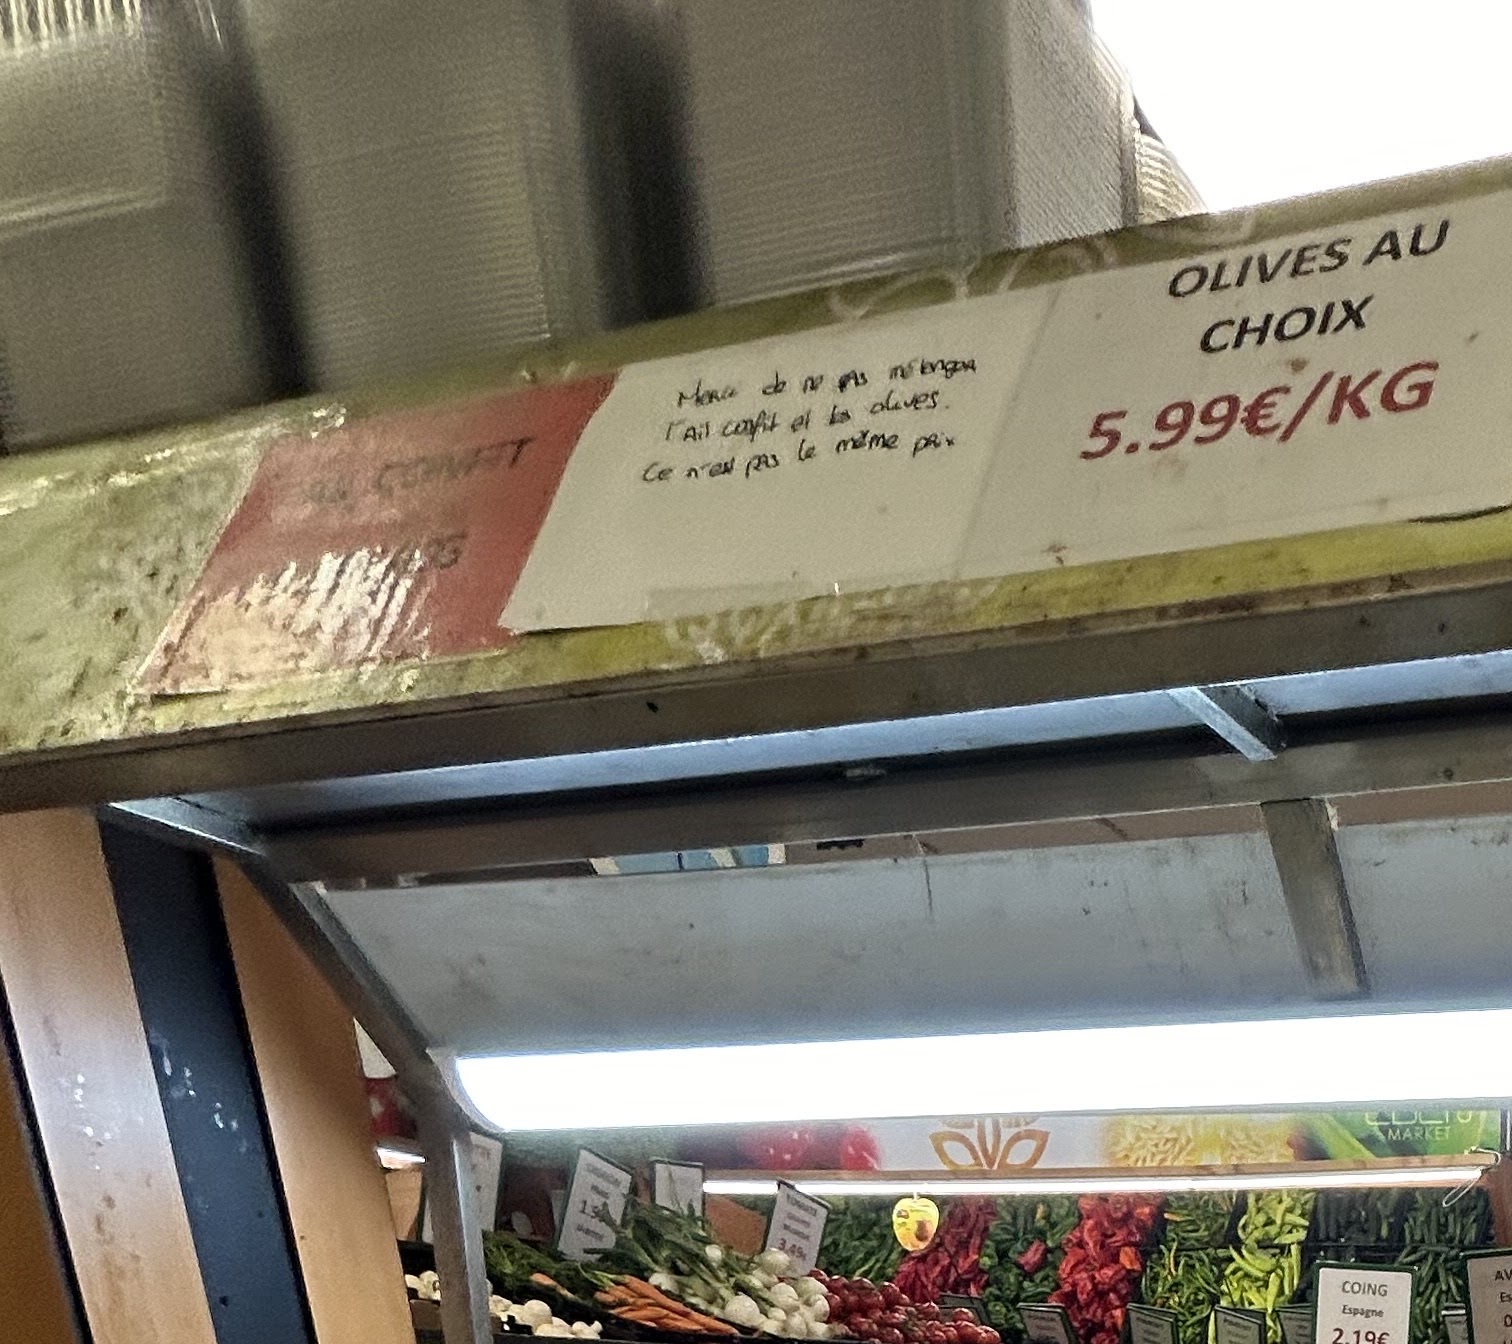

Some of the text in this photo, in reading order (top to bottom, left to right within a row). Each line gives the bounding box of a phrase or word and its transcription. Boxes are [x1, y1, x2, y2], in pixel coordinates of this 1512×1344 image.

[1167, 219, 1450, 300] OLIVES AU
[1199, 295, 1376, 354] CHOIX
[1079, 360, 1439, 461] 5.99€/KG
[642, 461, 673, 482] Ce
[1387, 1126, 1450, 1141] MARKET
[1342, 1280, 1388, 1297] COING
[1342, 1304, 1384, 1318] Espagne
